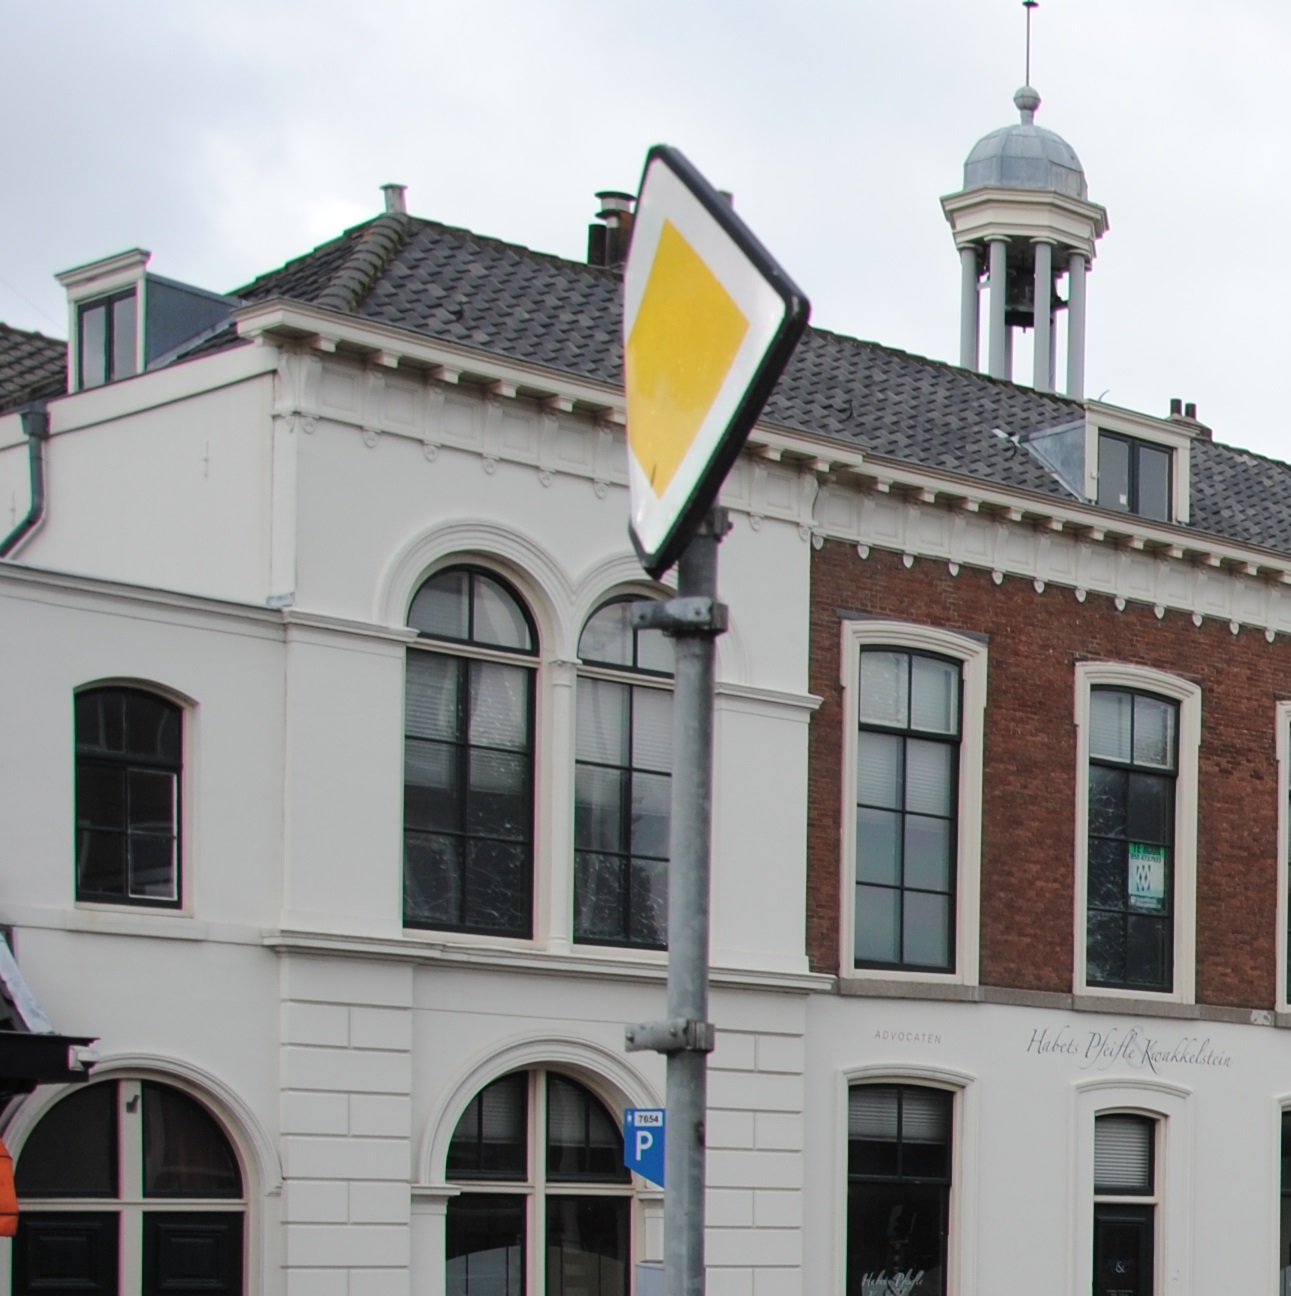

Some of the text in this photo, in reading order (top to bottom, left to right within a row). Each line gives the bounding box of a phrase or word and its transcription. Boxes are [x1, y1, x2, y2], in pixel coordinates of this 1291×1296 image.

[874, 1029, 942, 1045] ADVOCATEN
[1026, 1025, 1078, 1055] Habets
[1140, 1036, 1233, 1075] Kwakkelstein
[635, 1130, 654, 1161] P
